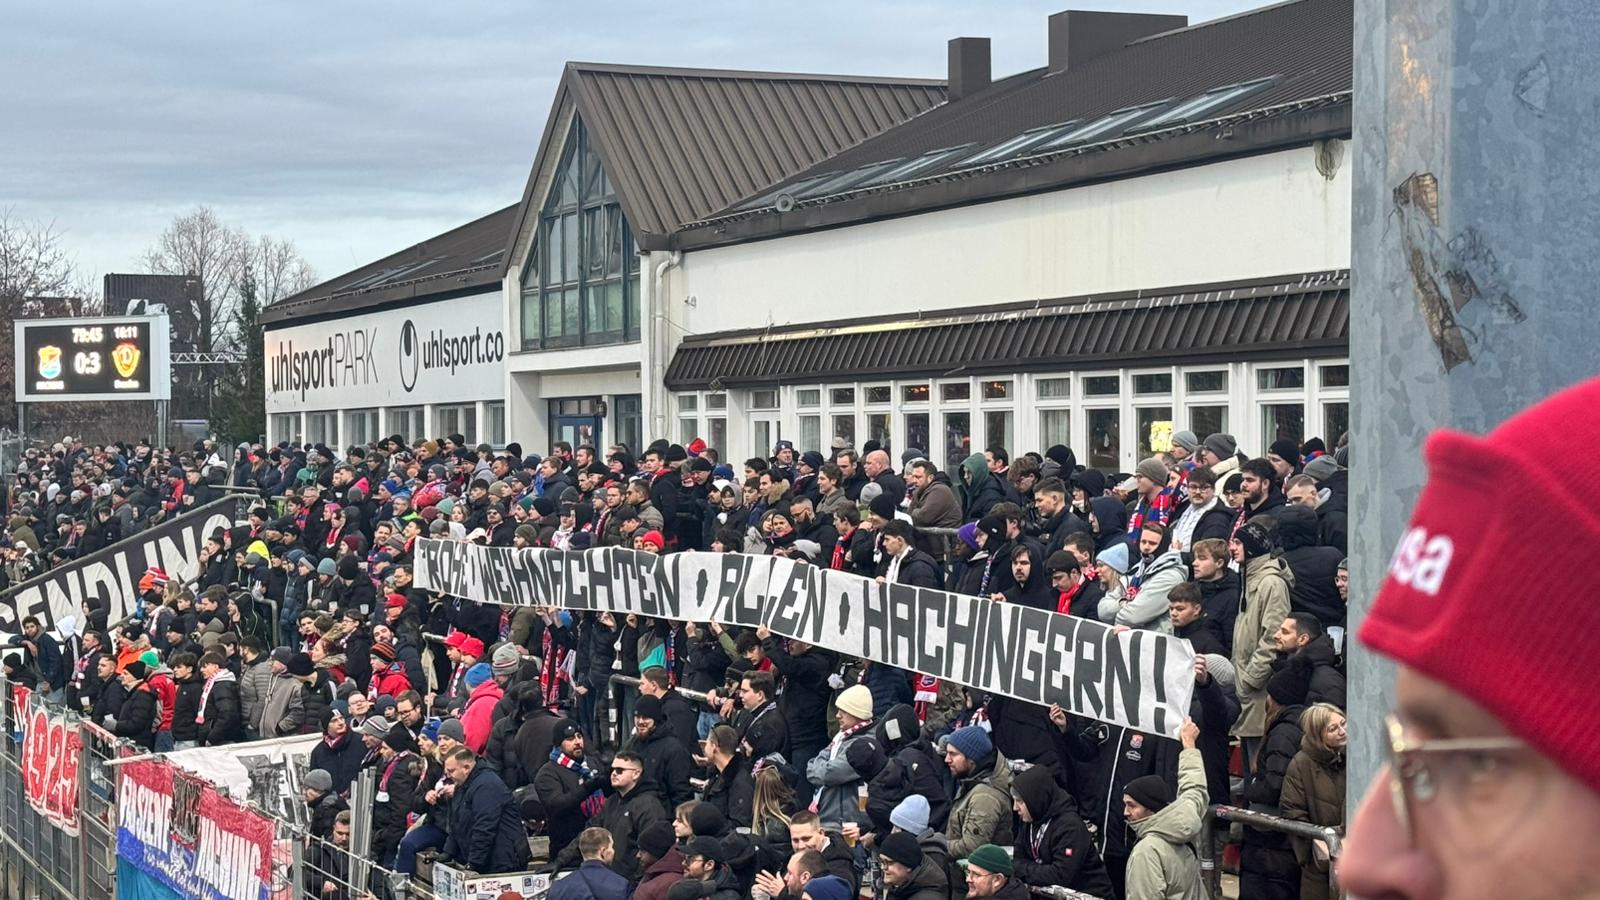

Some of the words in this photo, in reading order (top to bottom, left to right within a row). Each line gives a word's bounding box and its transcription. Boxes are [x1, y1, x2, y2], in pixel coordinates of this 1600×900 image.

[74, 351, 101, 375] 0:3
[477, 546, 681, 617] WEIHNACHTEN
[710, 554, 827, 643] ALLEN
